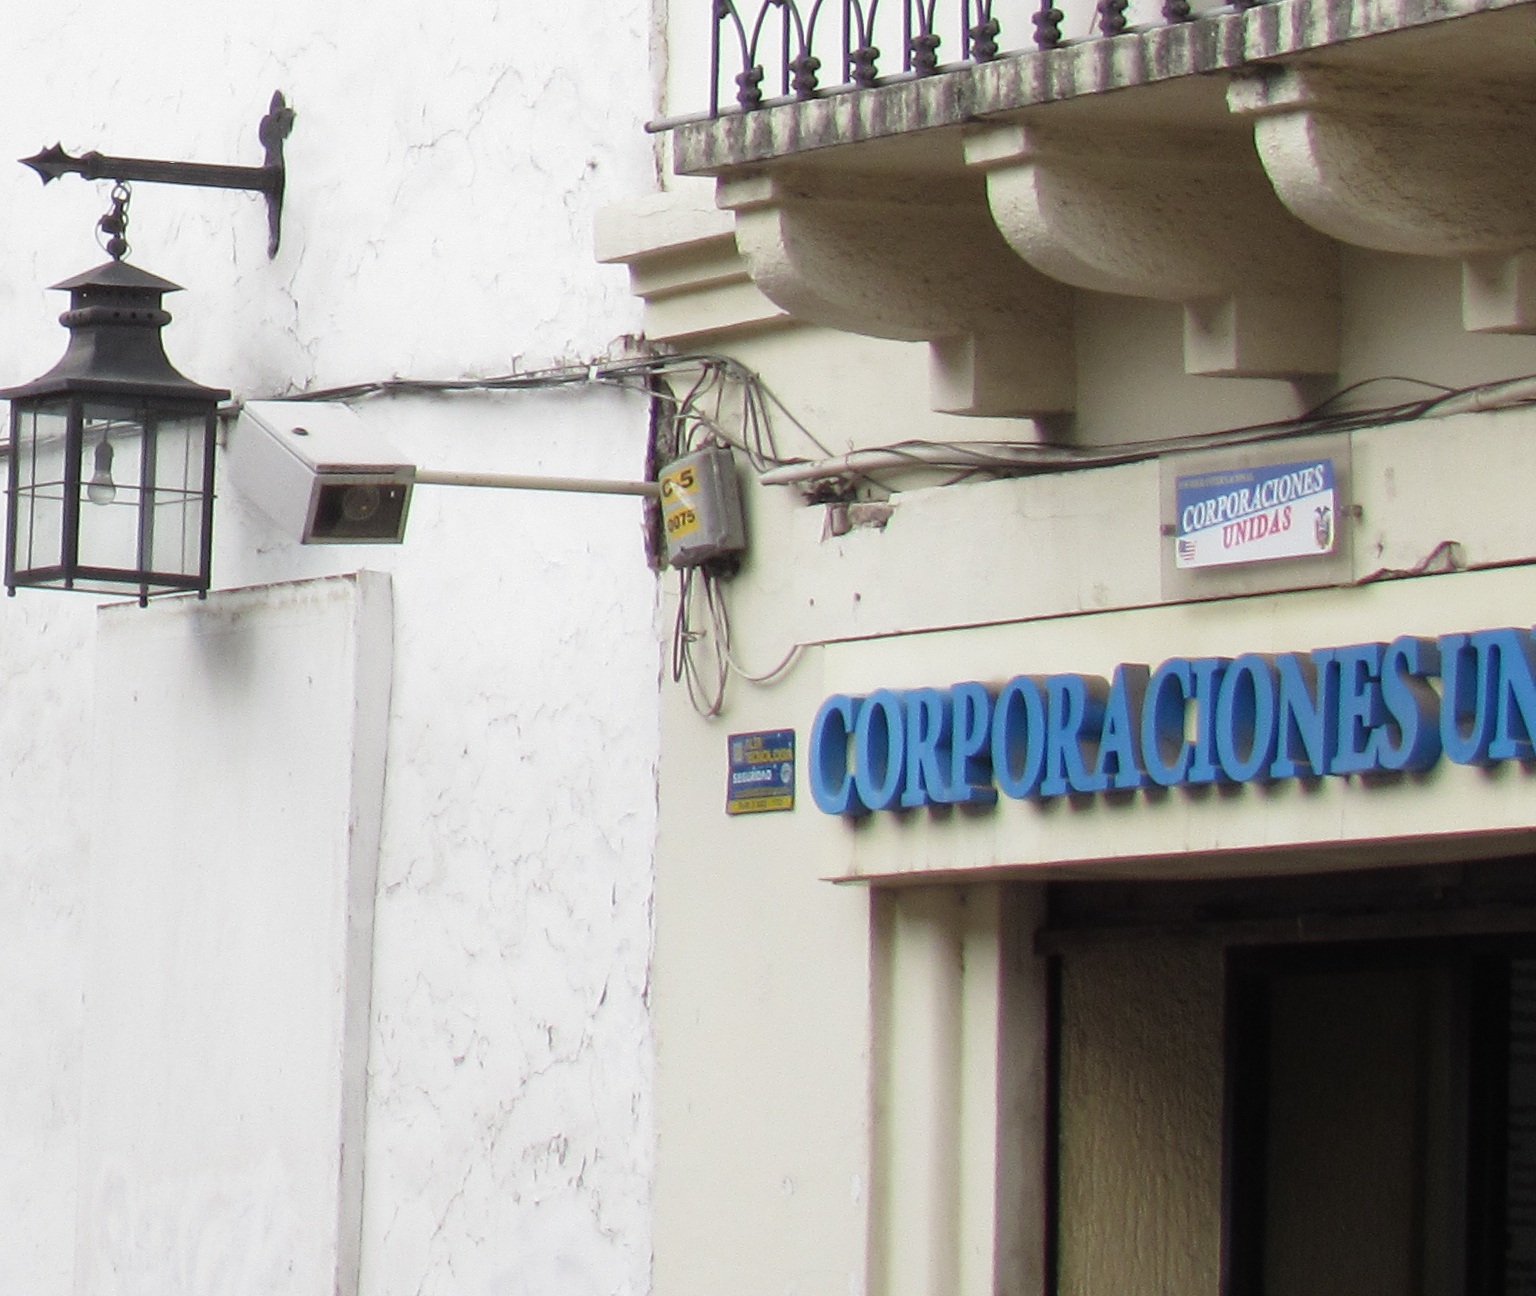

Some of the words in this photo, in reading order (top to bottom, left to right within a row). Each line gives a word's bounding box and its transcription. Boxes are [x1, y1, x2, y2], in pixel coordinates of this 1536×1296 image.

[1182, 464, 1324, 533] CORPORACIONES
[1222, 505, 1292, 549] UNIDAS
[809, 636, 1441, 816] CORPORACIONES
